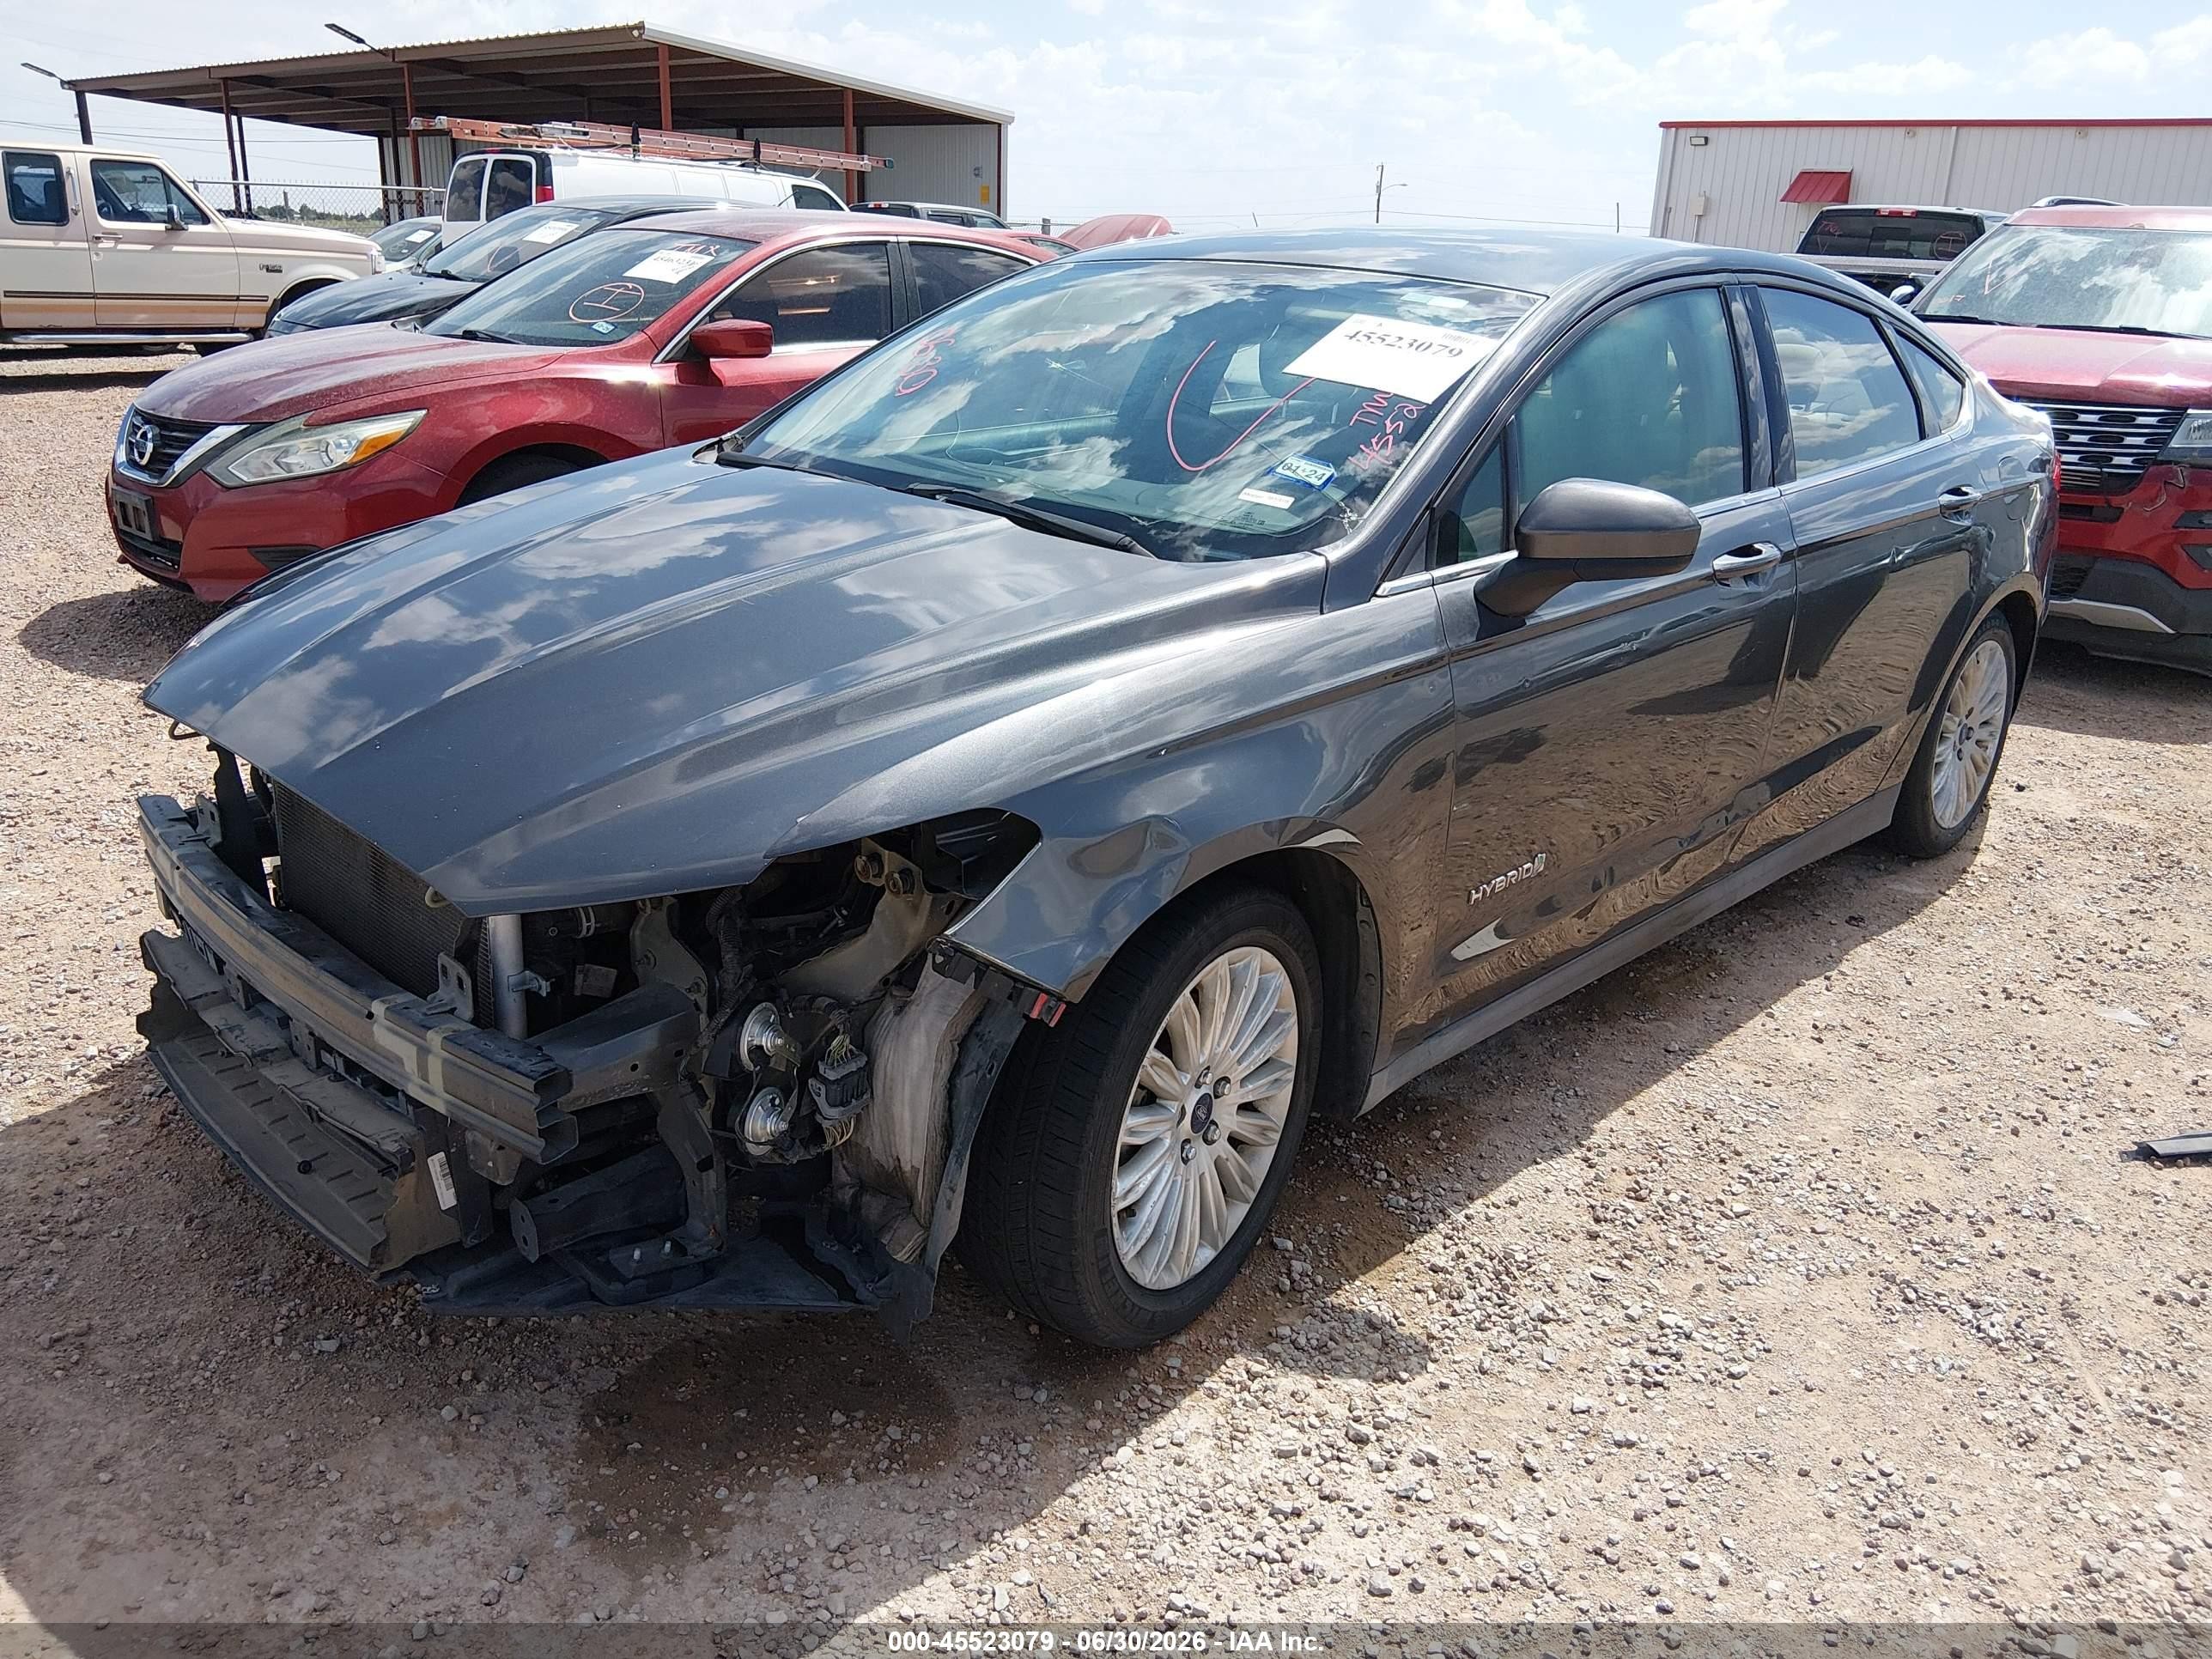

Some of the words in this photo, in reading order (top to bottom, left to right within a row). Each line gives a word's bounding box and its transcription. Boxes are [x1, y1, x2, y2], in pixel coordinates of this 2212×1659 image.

[1344, 330, 1464, 358] 45523079
[1347, 403, 1427, 470] 4552
[1469, 861, 1534, 905] HYBRID
